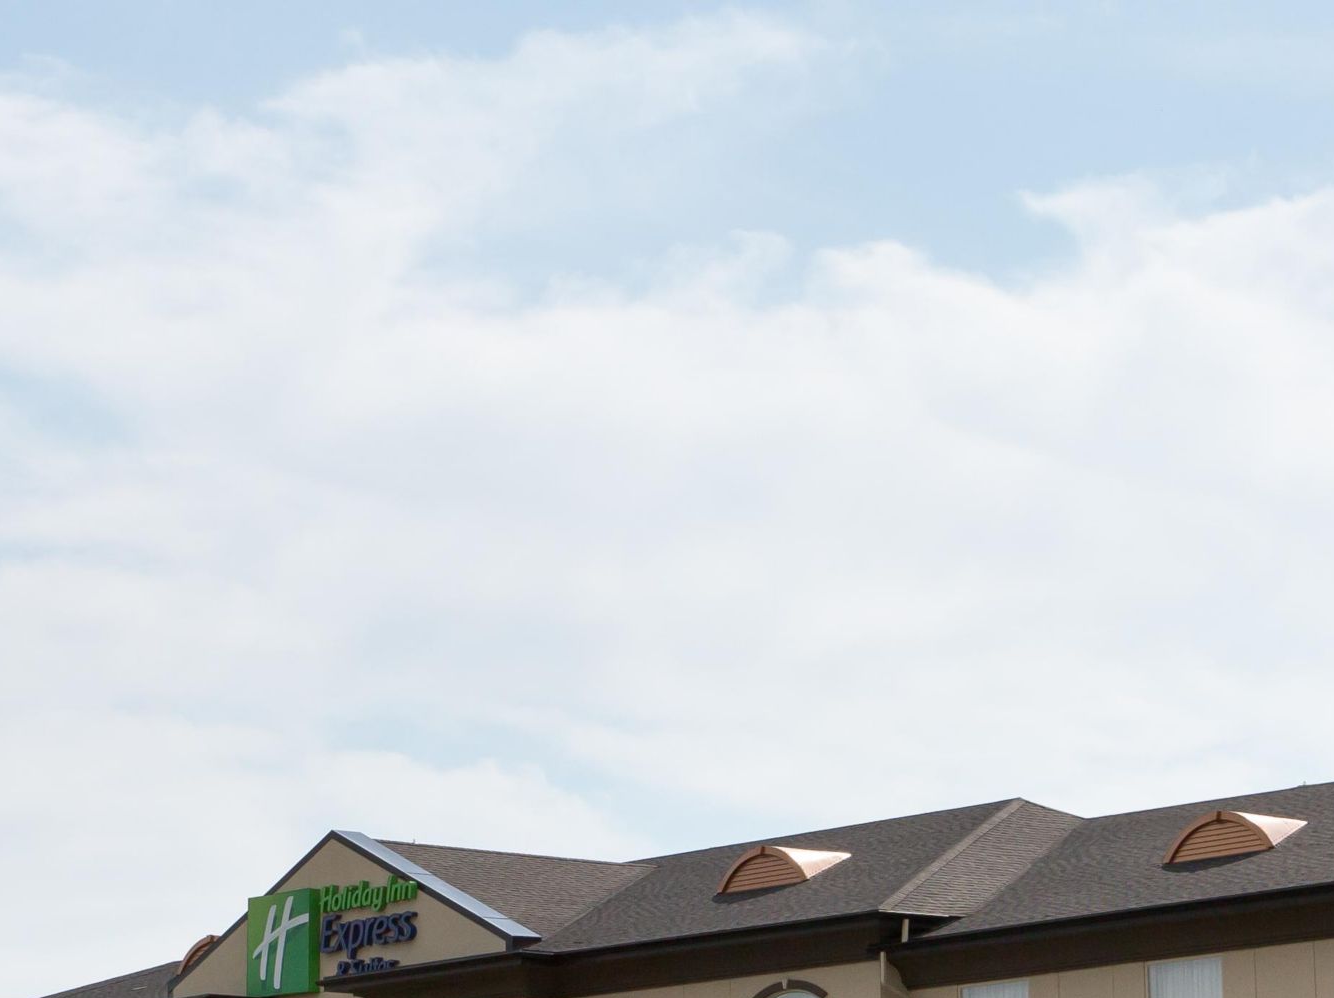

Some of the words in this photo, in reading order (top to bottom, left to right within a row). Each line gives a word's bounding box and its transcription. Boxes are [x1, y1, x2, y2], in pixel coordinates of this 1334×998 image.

[320, 879, 387, 913] Holiday
[385, 875, 417, 904] Inn
[320, 911, 418, 960] Express
